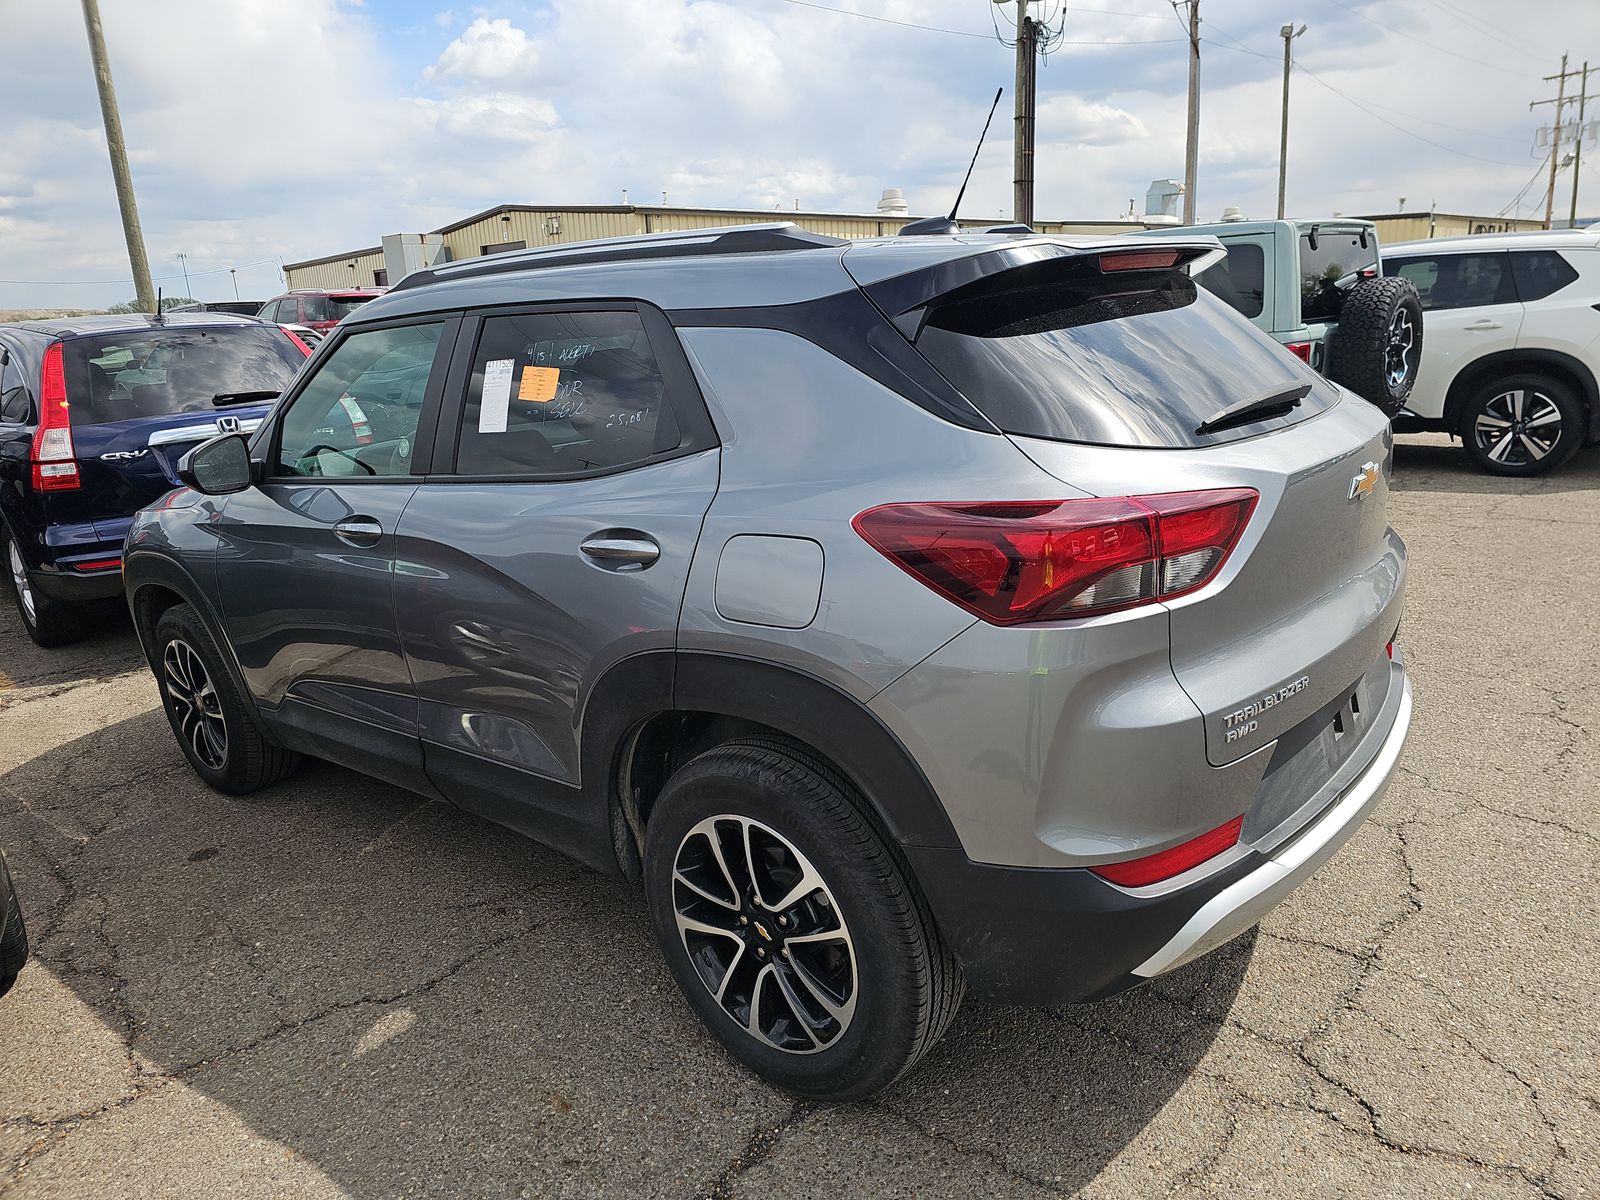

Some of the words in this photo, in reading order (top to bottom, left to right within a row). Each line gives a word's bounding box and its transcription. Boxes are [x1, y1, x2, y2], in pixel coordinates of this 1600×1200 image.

[606, 408, 649, 429] 25,081
[100, 450, 149, 460] CR-V
[1222, 675, 1310, 728] TRAILBLAZER
[1225, 720, 1258, 743] AWD
